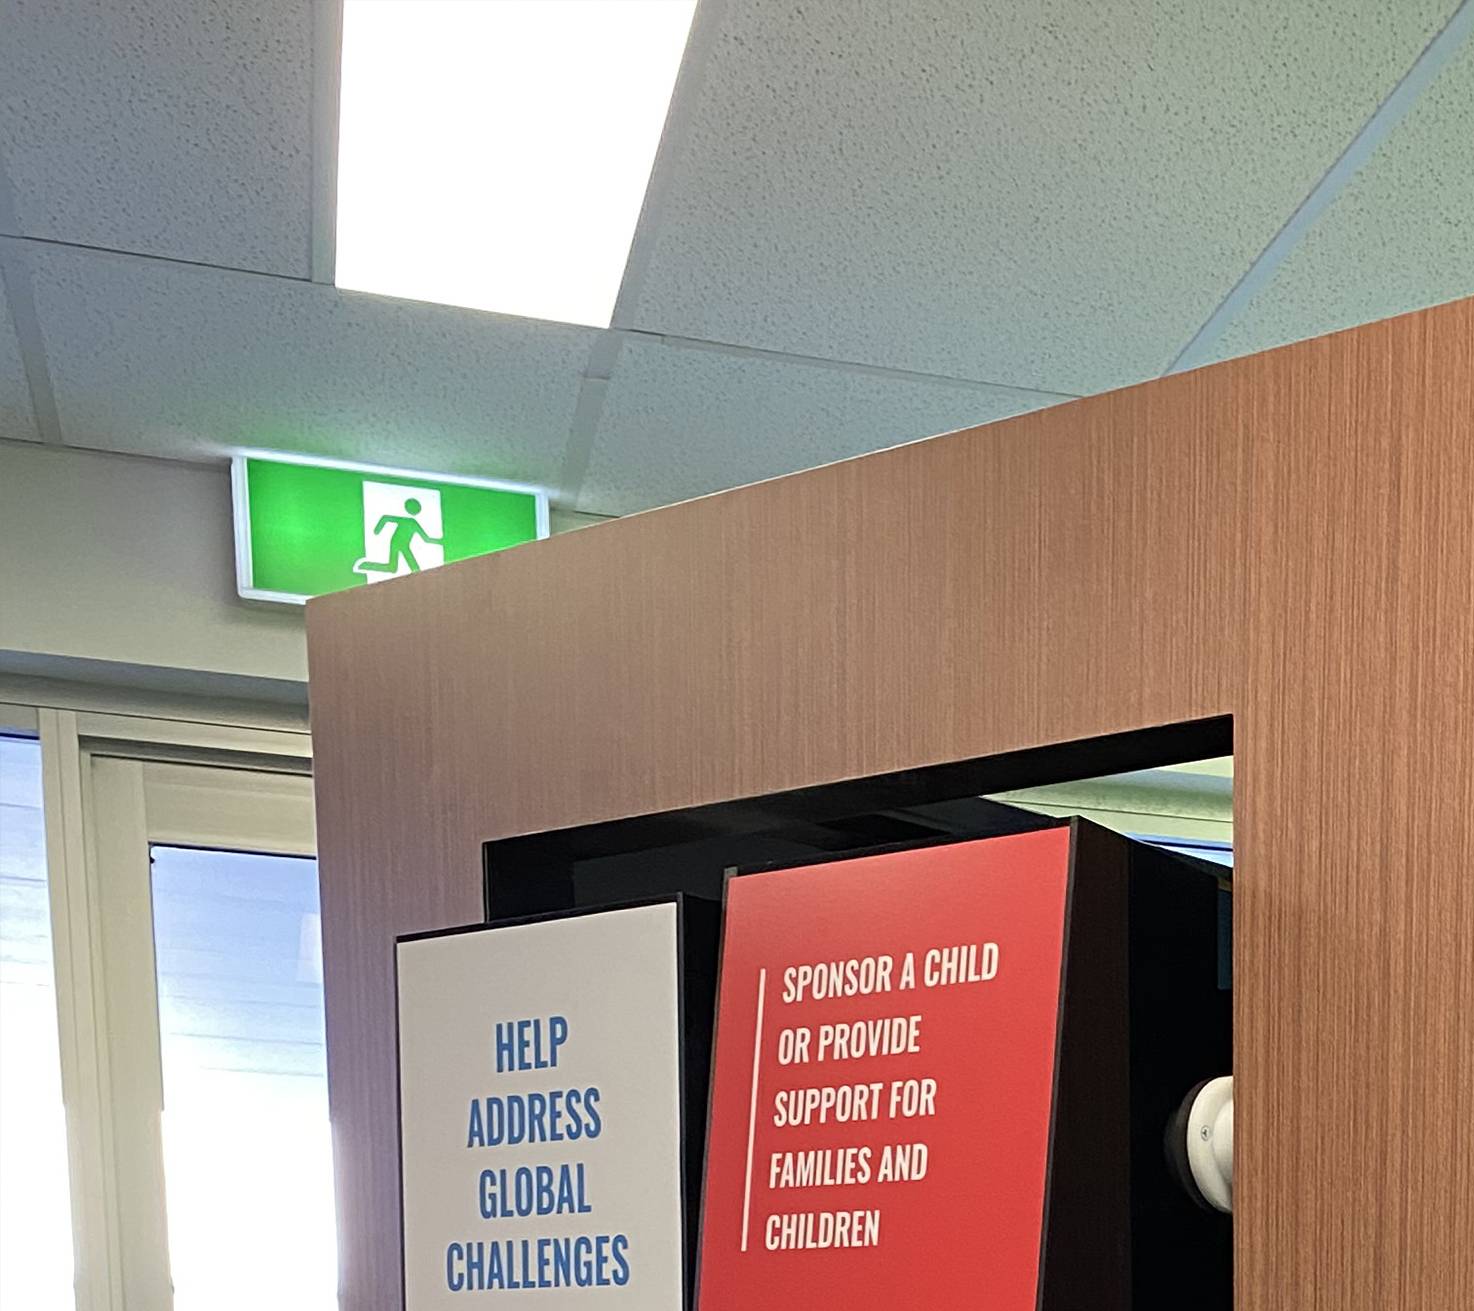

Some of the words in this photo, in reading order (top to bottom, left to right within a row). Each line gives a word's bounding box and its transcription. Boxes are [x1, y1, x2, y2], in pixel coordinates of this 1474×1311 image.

[782, 954, 893, 1003] SPONSOR
[900, 952, 917, 990] A
[924, 942, 1000, 988] CHILD
[495, 1016, 567, 1072] HELP
[778, 1025, 811, 1066] OR
[818, 1016, 921, 1063] PROVIDE
[467, 1087, 602, 1148] ADDRESS
[774, 1083, 882, 1128] SUPPORT
[890, 1078, 936, 1119] FOR
[479, 1163, 592, 1219] GLOBAL
[769, 1147, 871, 1190] FAMILIES
[878, 1142, 928, 1181] AND
[765, 1209, 880, 1251] CHILDREN
[446, 1235, 630, 1291] CHALLENGES
